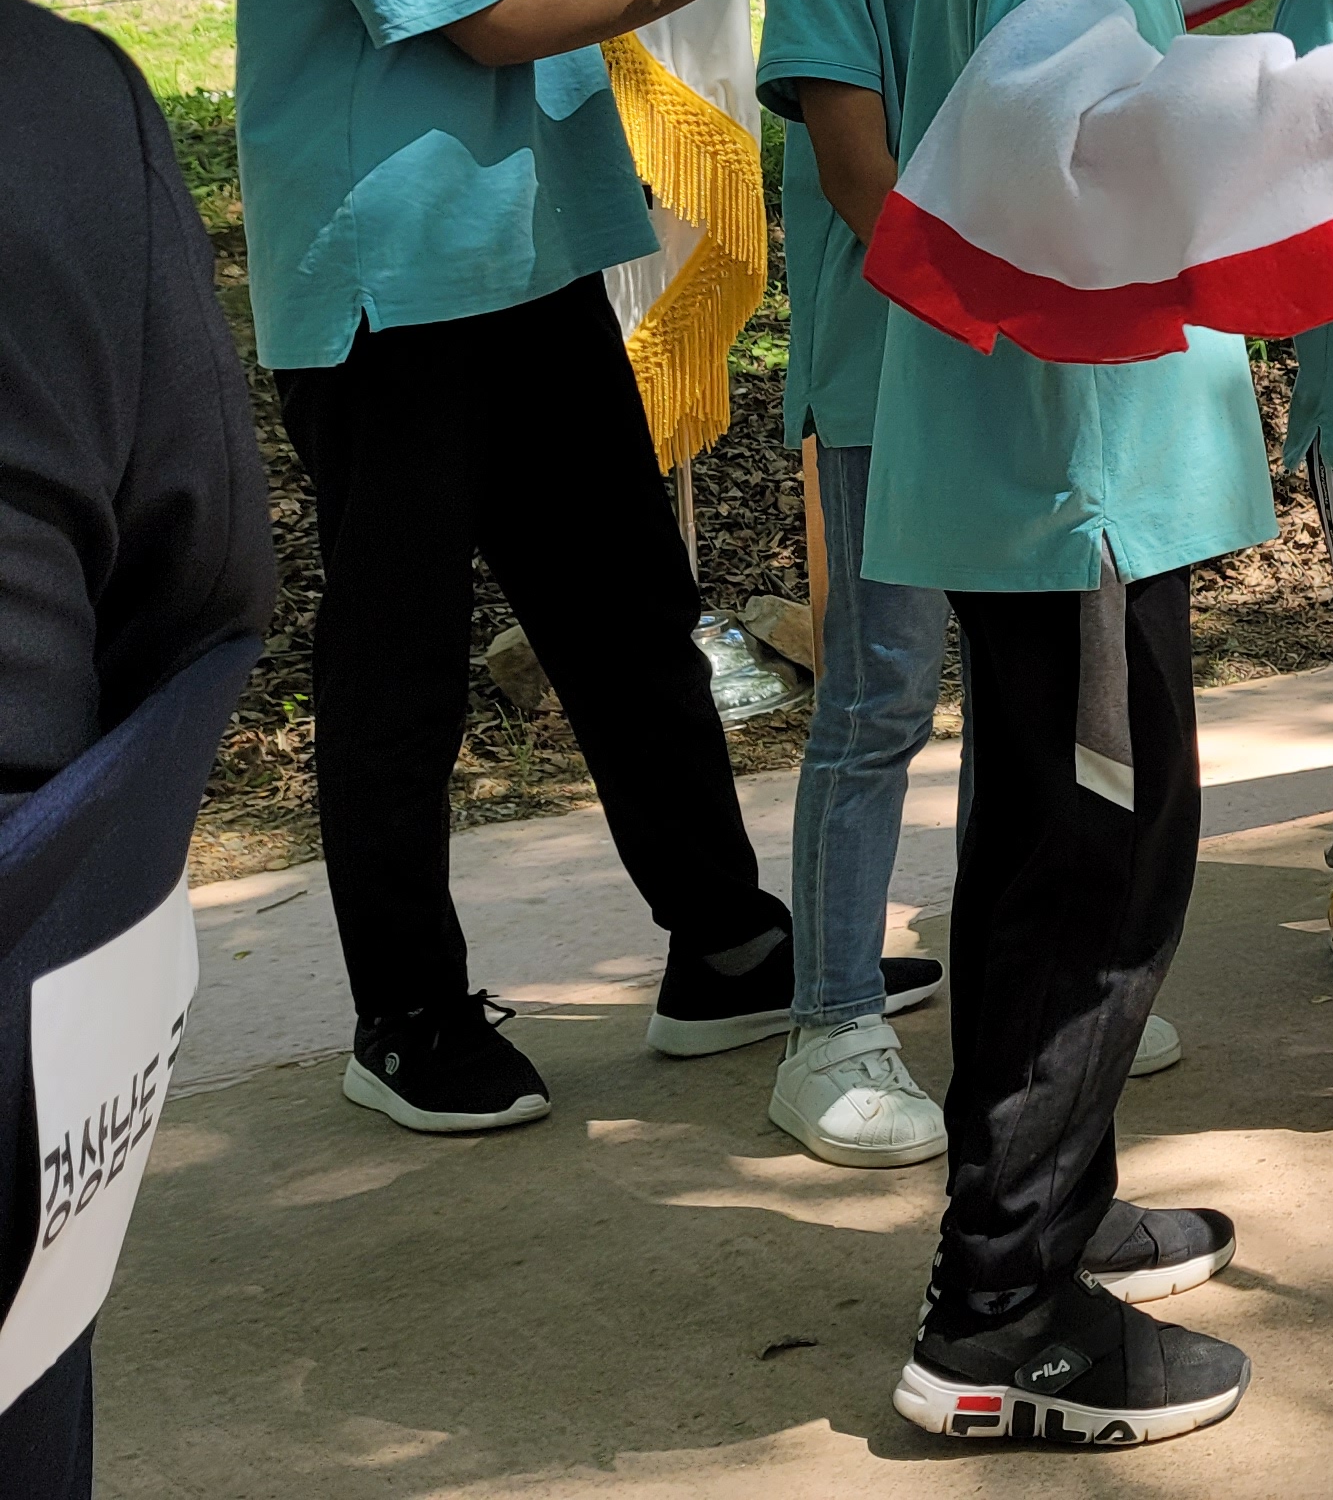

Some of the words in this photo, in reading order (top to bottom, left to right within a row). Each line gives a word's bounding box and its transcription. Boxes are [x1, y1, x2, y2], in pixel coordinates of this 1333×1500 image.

[42, 1051, 160, 1250] 경상남도
[1031, 1358, 1071, 1382] FILA
[950, 1395, 1139, 1443] FILA
